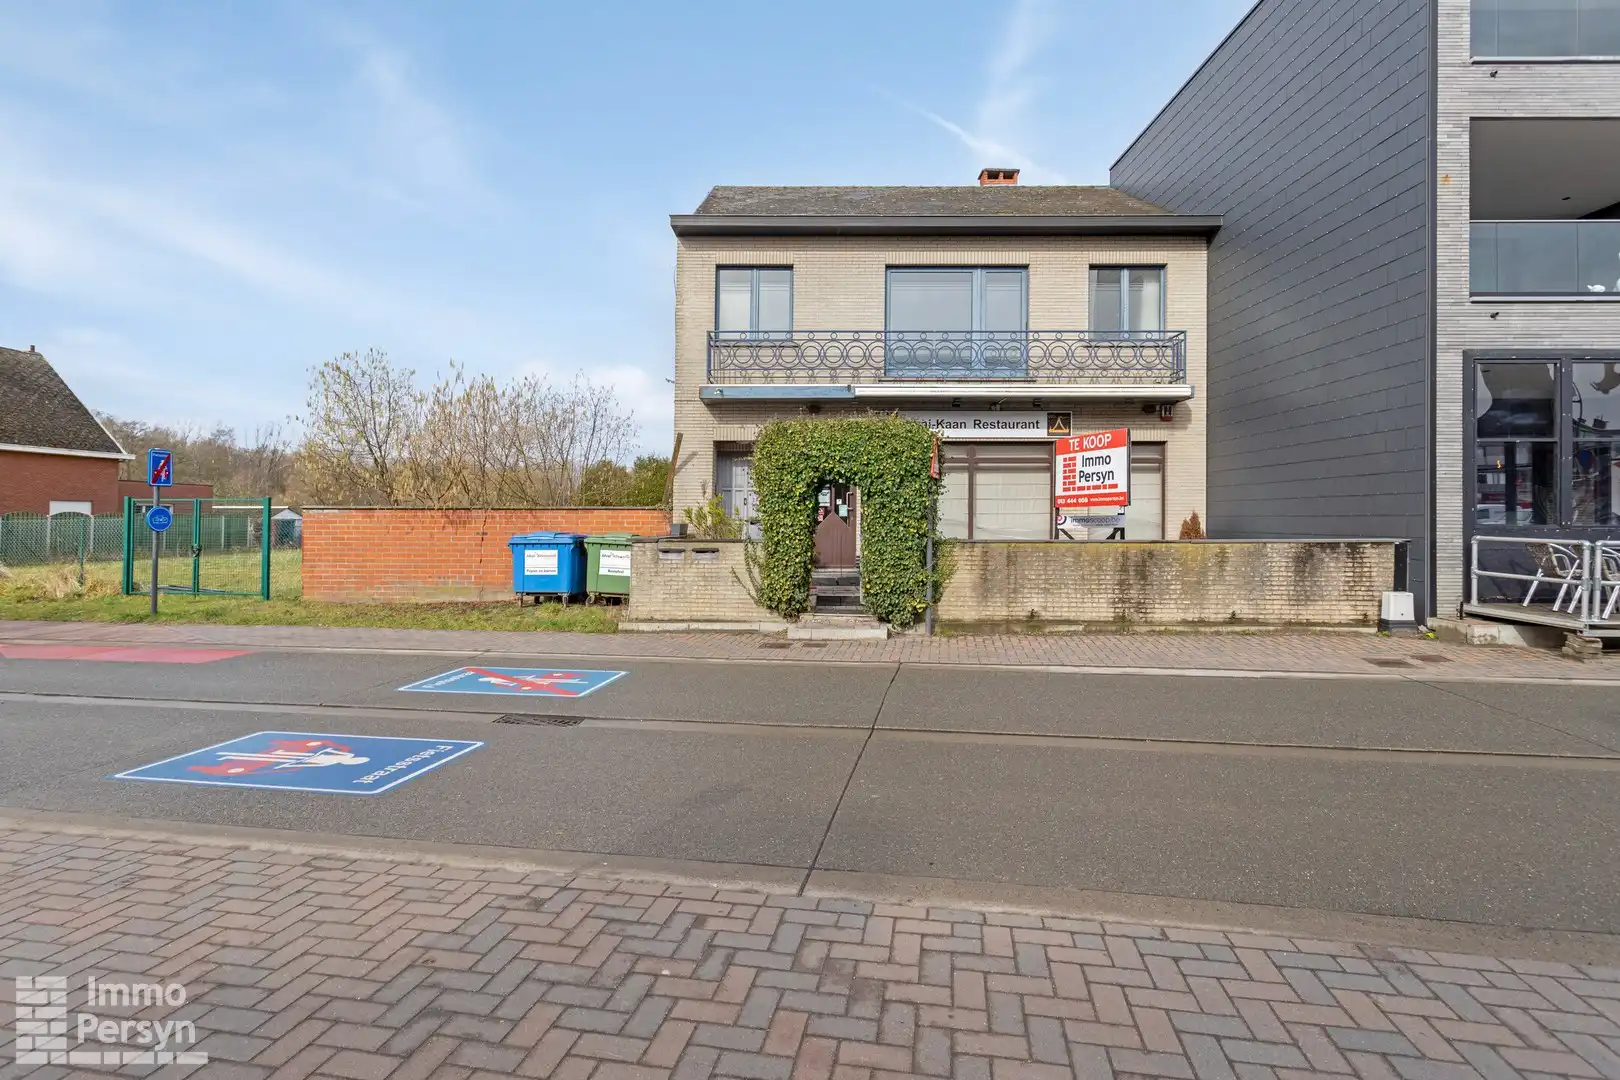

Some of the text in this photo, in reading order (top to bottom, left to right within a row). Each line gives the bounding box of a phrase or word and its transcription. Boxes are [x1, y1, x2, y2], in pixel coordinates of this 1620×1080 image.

[973, 419, 1040, 430] Restaurant
[1068, 433, 1112, 451] TE KOOP
[1081, 454, 1112, 468] Immo
[1078, 470, 1115, 484] Persyn
[353, 745, 454, 784] Fietsstraat
